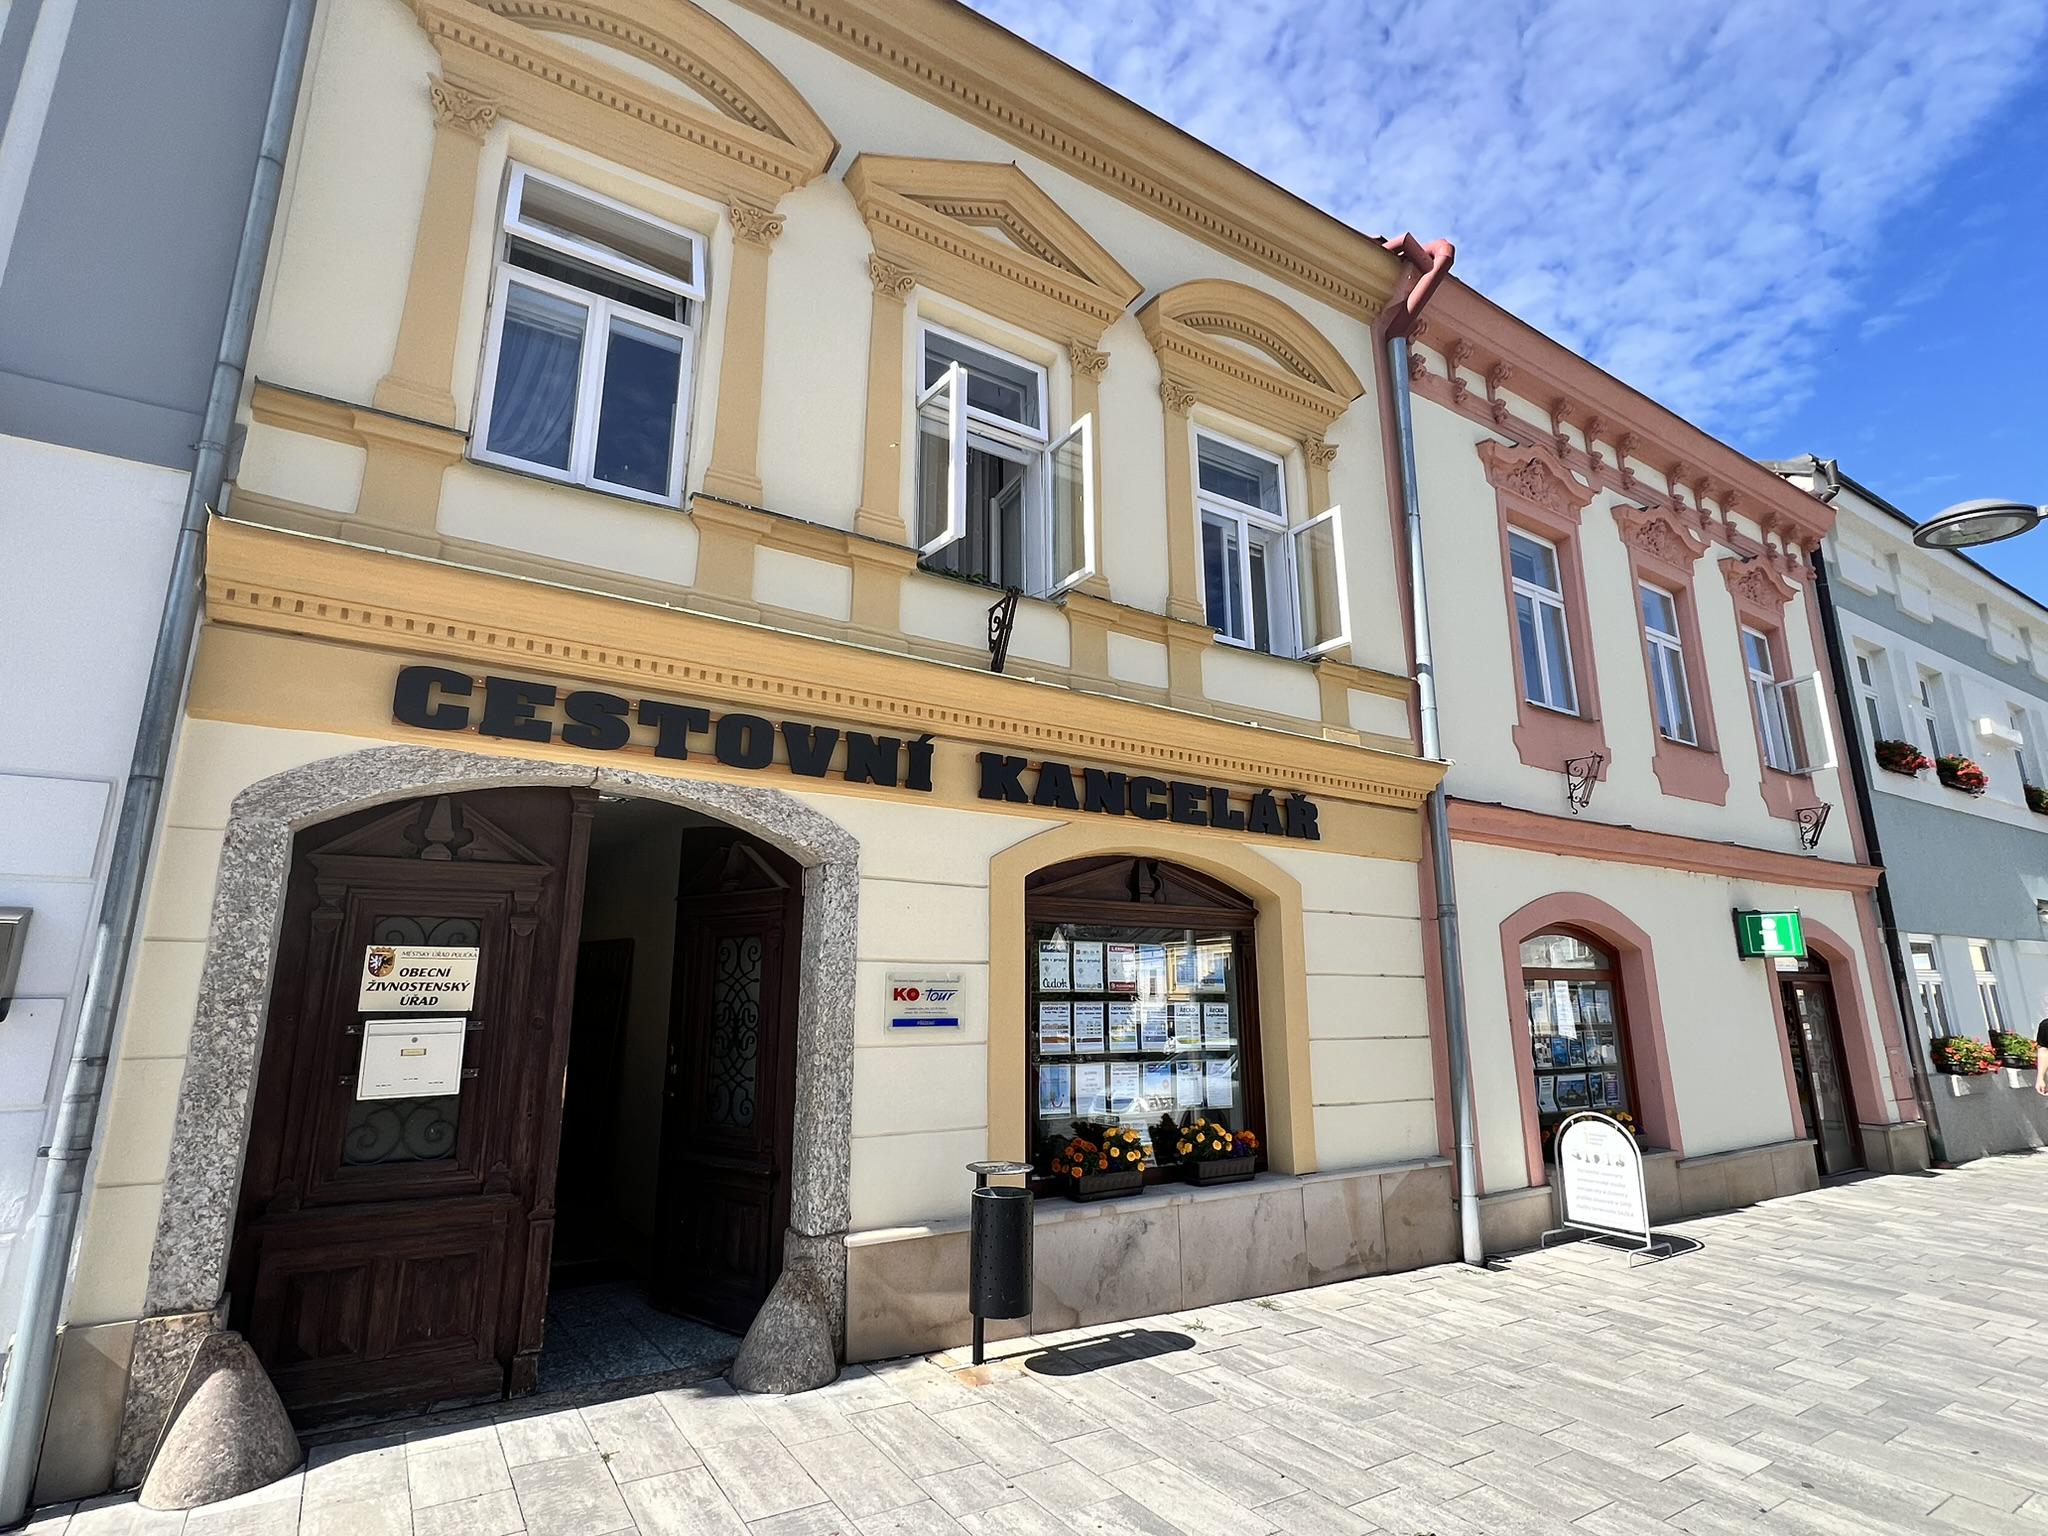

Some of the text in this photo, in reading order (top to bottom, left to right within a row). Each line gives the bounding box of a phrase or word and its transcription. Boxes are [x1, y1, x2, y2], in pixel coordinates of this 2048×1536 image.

[393, 666, 1321, 841] CESTOVNÍ KANCELÁŘ
[400, 966, 452, 977] OBECNÍ
[366, 980, 470, 991] ŽIVNOSTENSKÝ
[400, 994, 438, 1005] ÚŘAD
